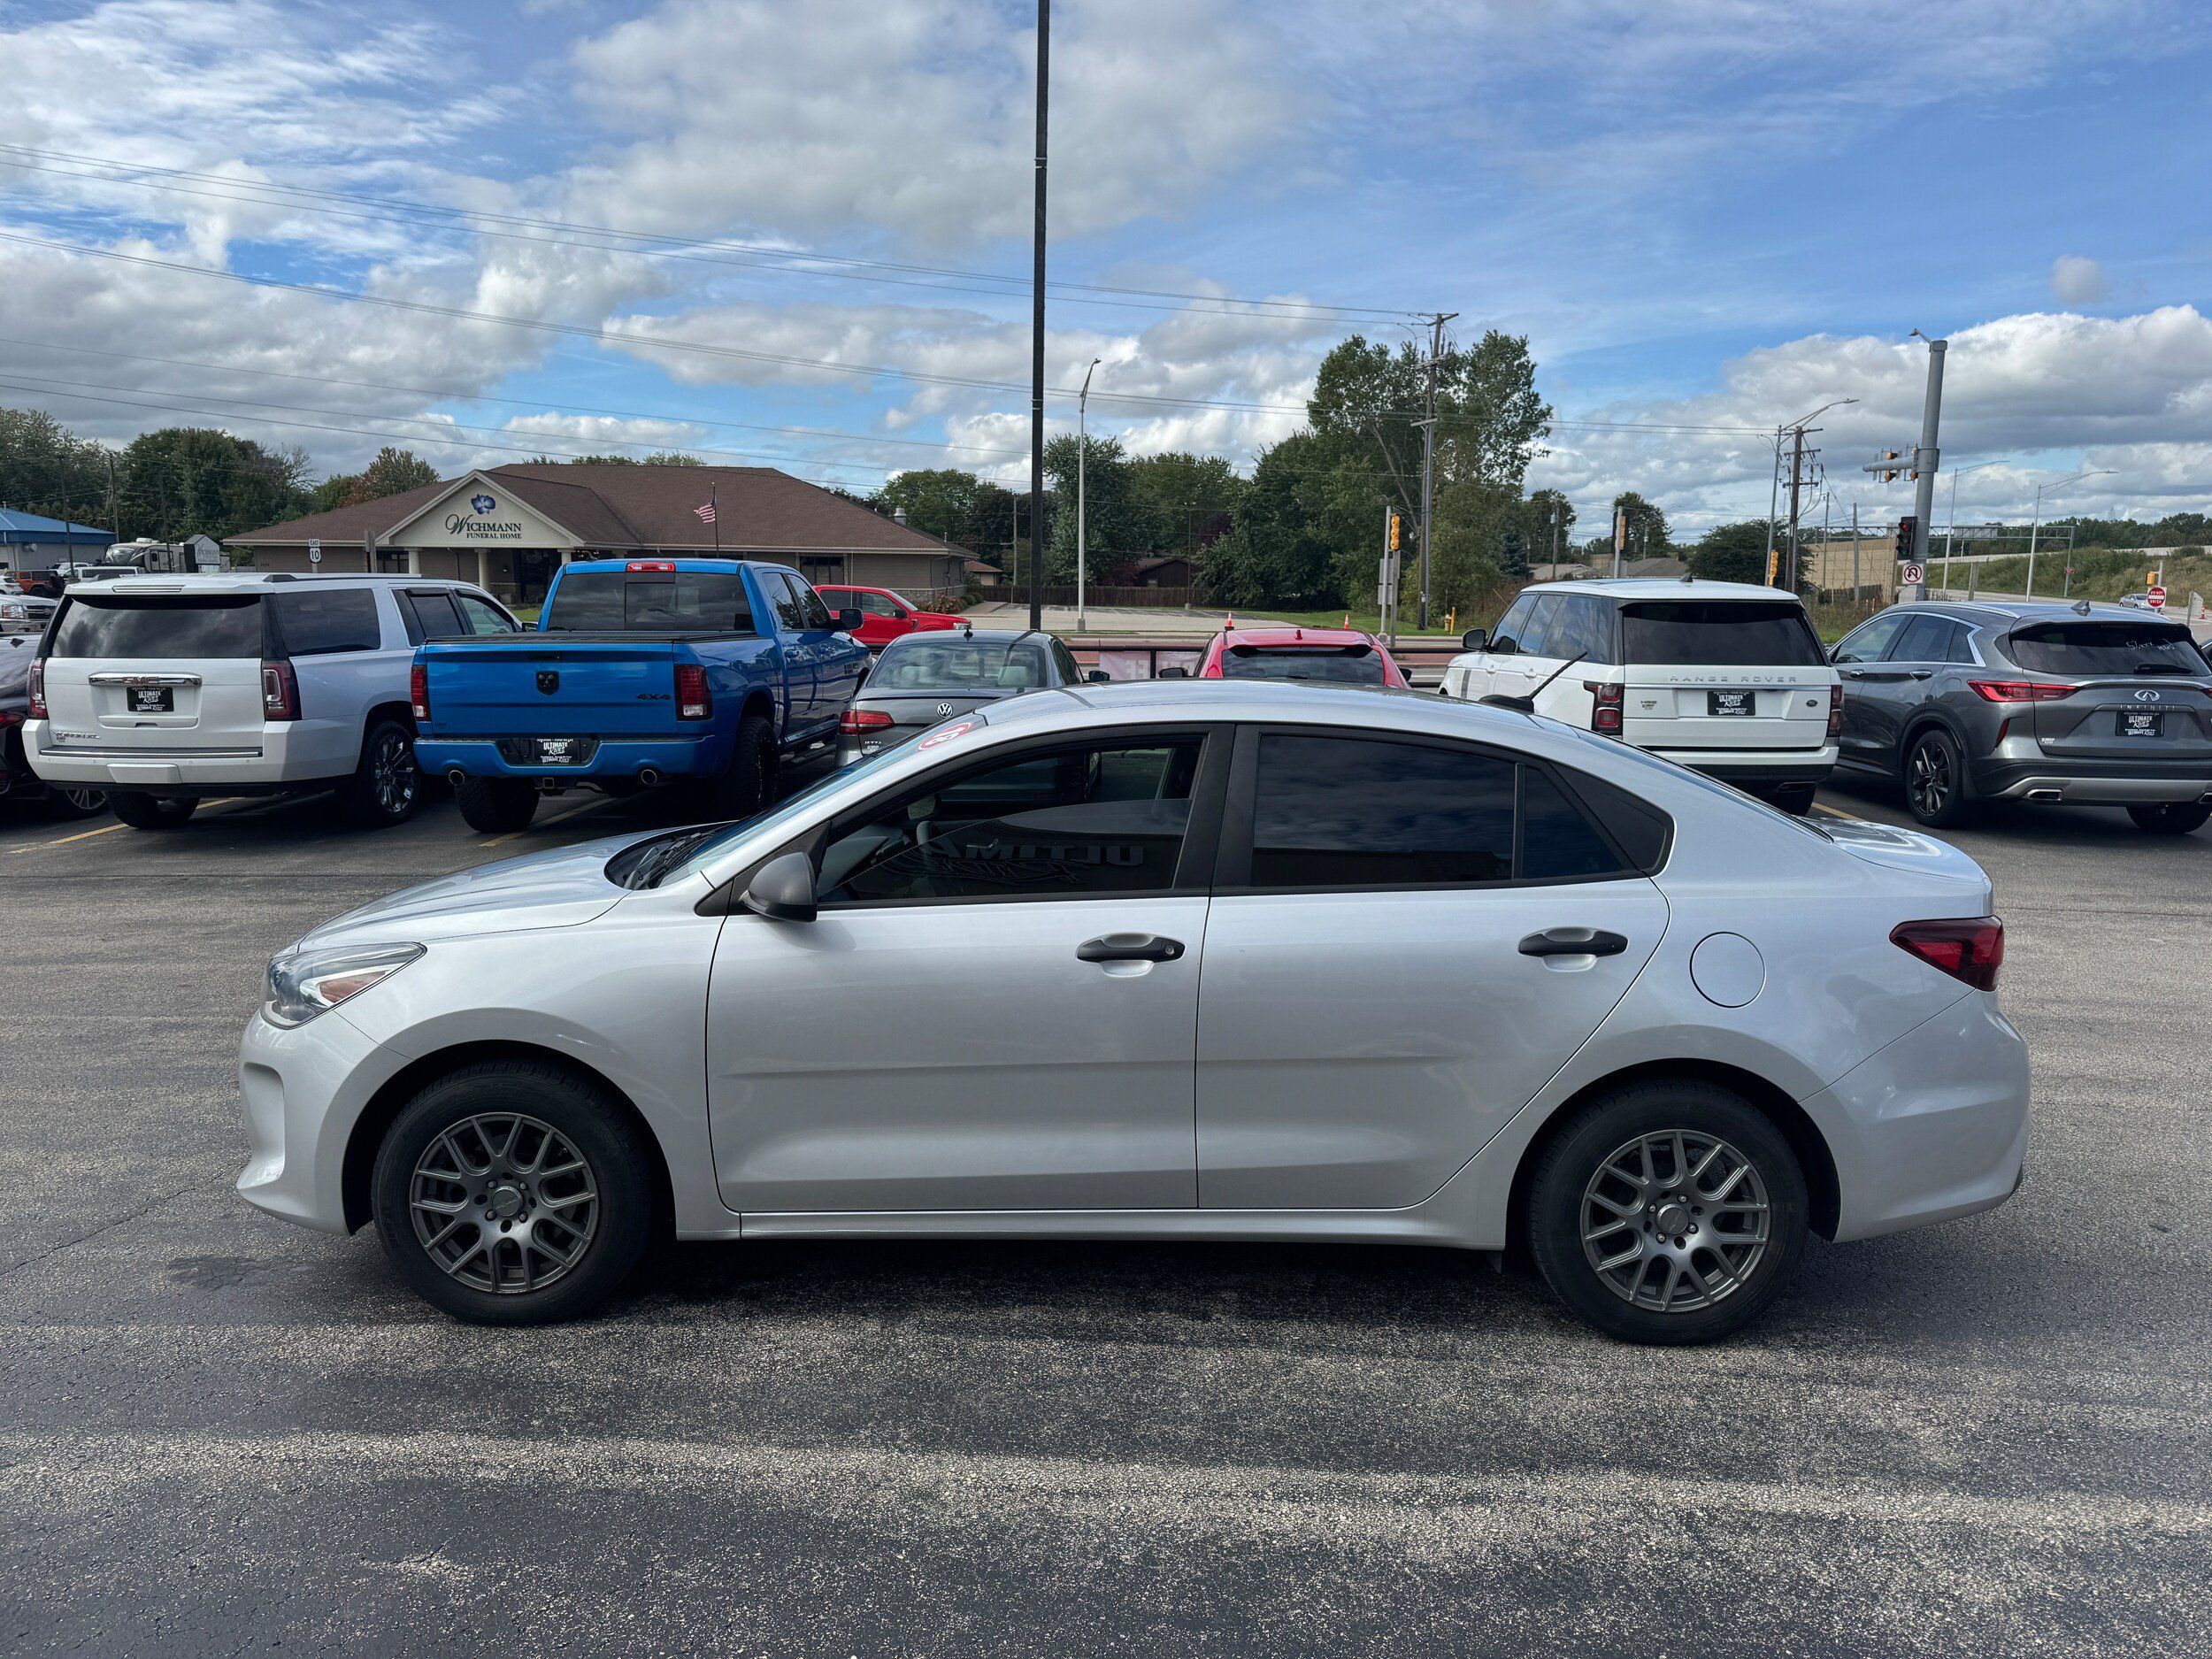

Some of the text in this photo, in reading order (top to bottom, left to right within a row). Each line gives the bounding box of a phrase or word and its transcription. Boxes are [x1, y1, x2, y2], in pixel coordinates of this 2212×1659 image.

[311, 550, 319, 559] 10
[123, 676, 159, 685] GMC
[543, 741, 568, 750] ULTIMATE
